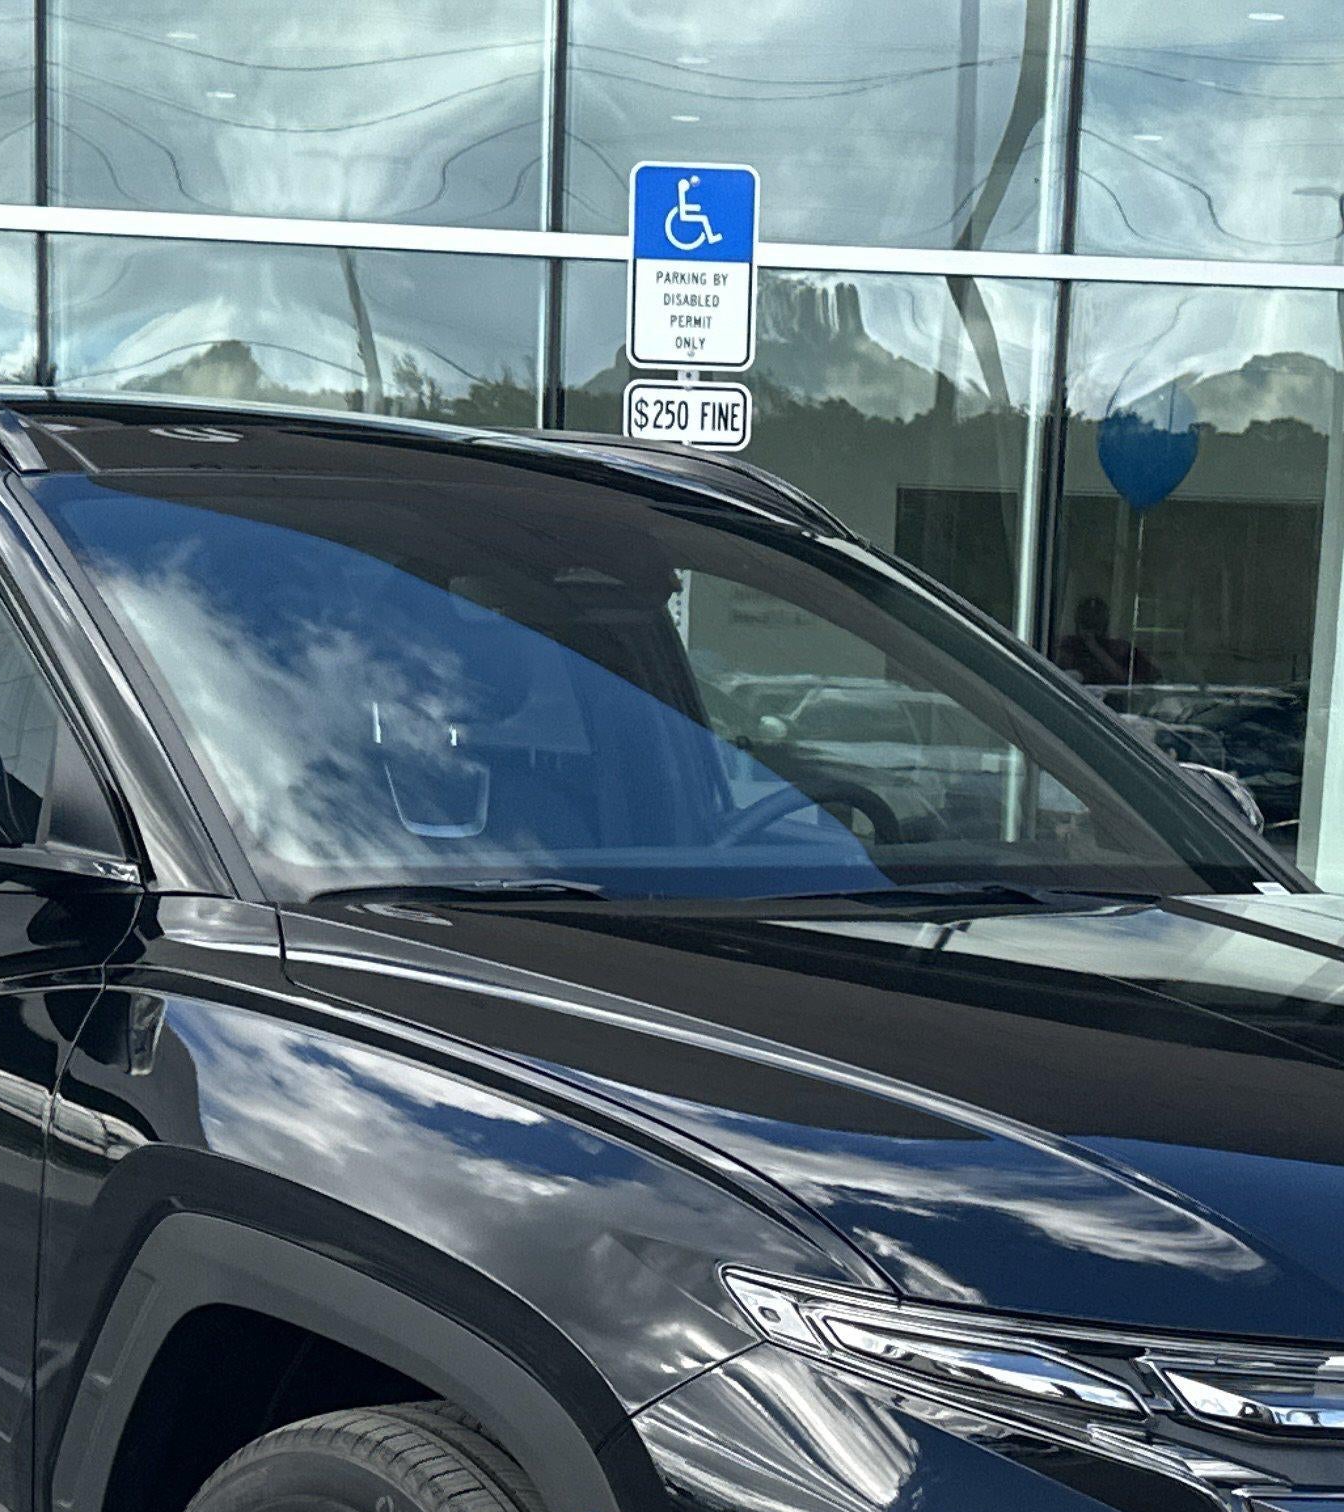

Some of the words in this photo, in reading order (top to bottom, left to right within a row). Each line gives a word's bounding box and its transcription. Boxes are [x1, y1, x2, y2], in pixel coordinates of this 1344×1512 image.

[655, 270, 707, 285] PARKING
[713, 272, 729, 286] BY
[663, 293, 720, 308] DISABLED
[670, 315, 713, 330] PERMIT
[675, 335, 706, 351] ONLY
[634, 396, 689, 431] $250
[700, 401, 741, 432] FINE
